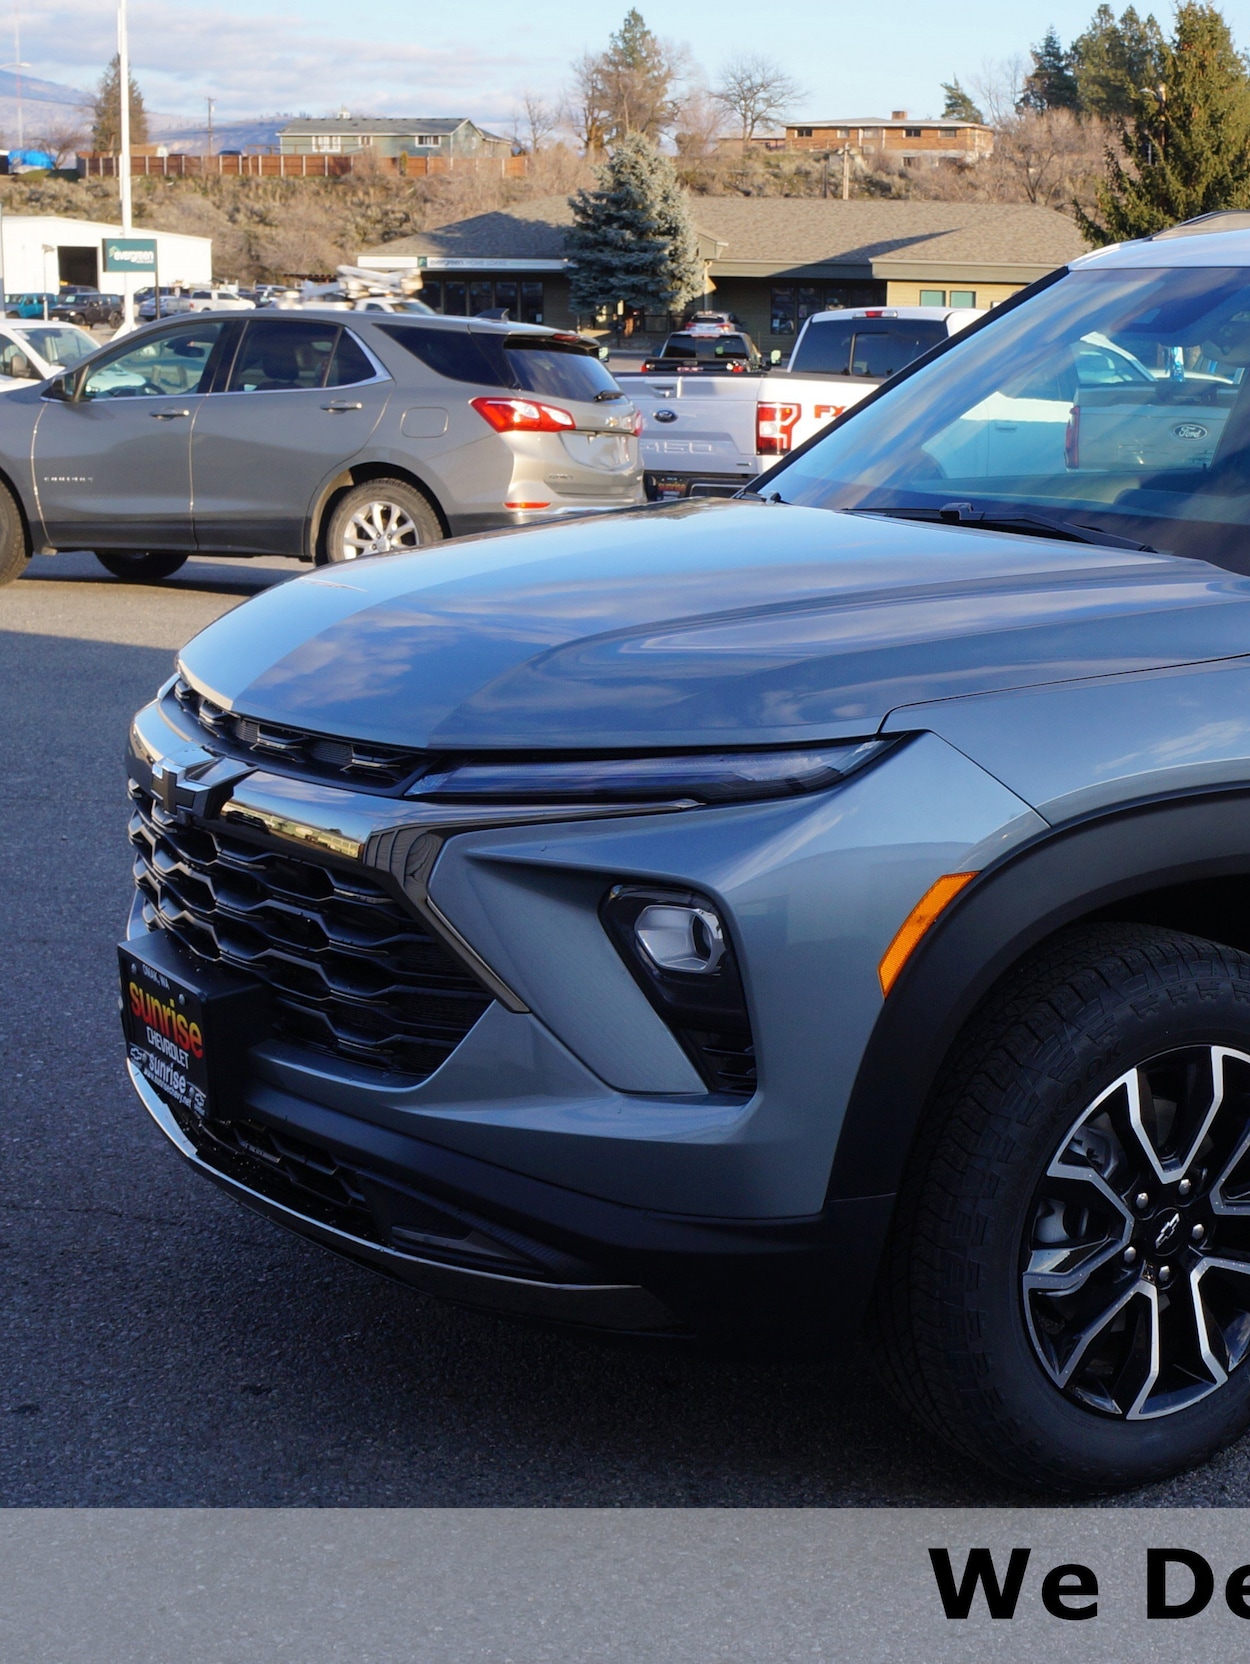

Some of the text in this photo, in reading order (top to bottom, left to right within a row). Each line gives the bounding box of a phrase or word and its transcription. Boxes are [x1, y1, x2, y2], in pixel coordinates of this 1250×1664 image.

[1179, 426, 1201, 438] Ford
[129, 981, 204, 1059] sunrise
[146, 1026, 189, 1070] CHEVROLET
[148, 1053, 187, 1094] sunrise
